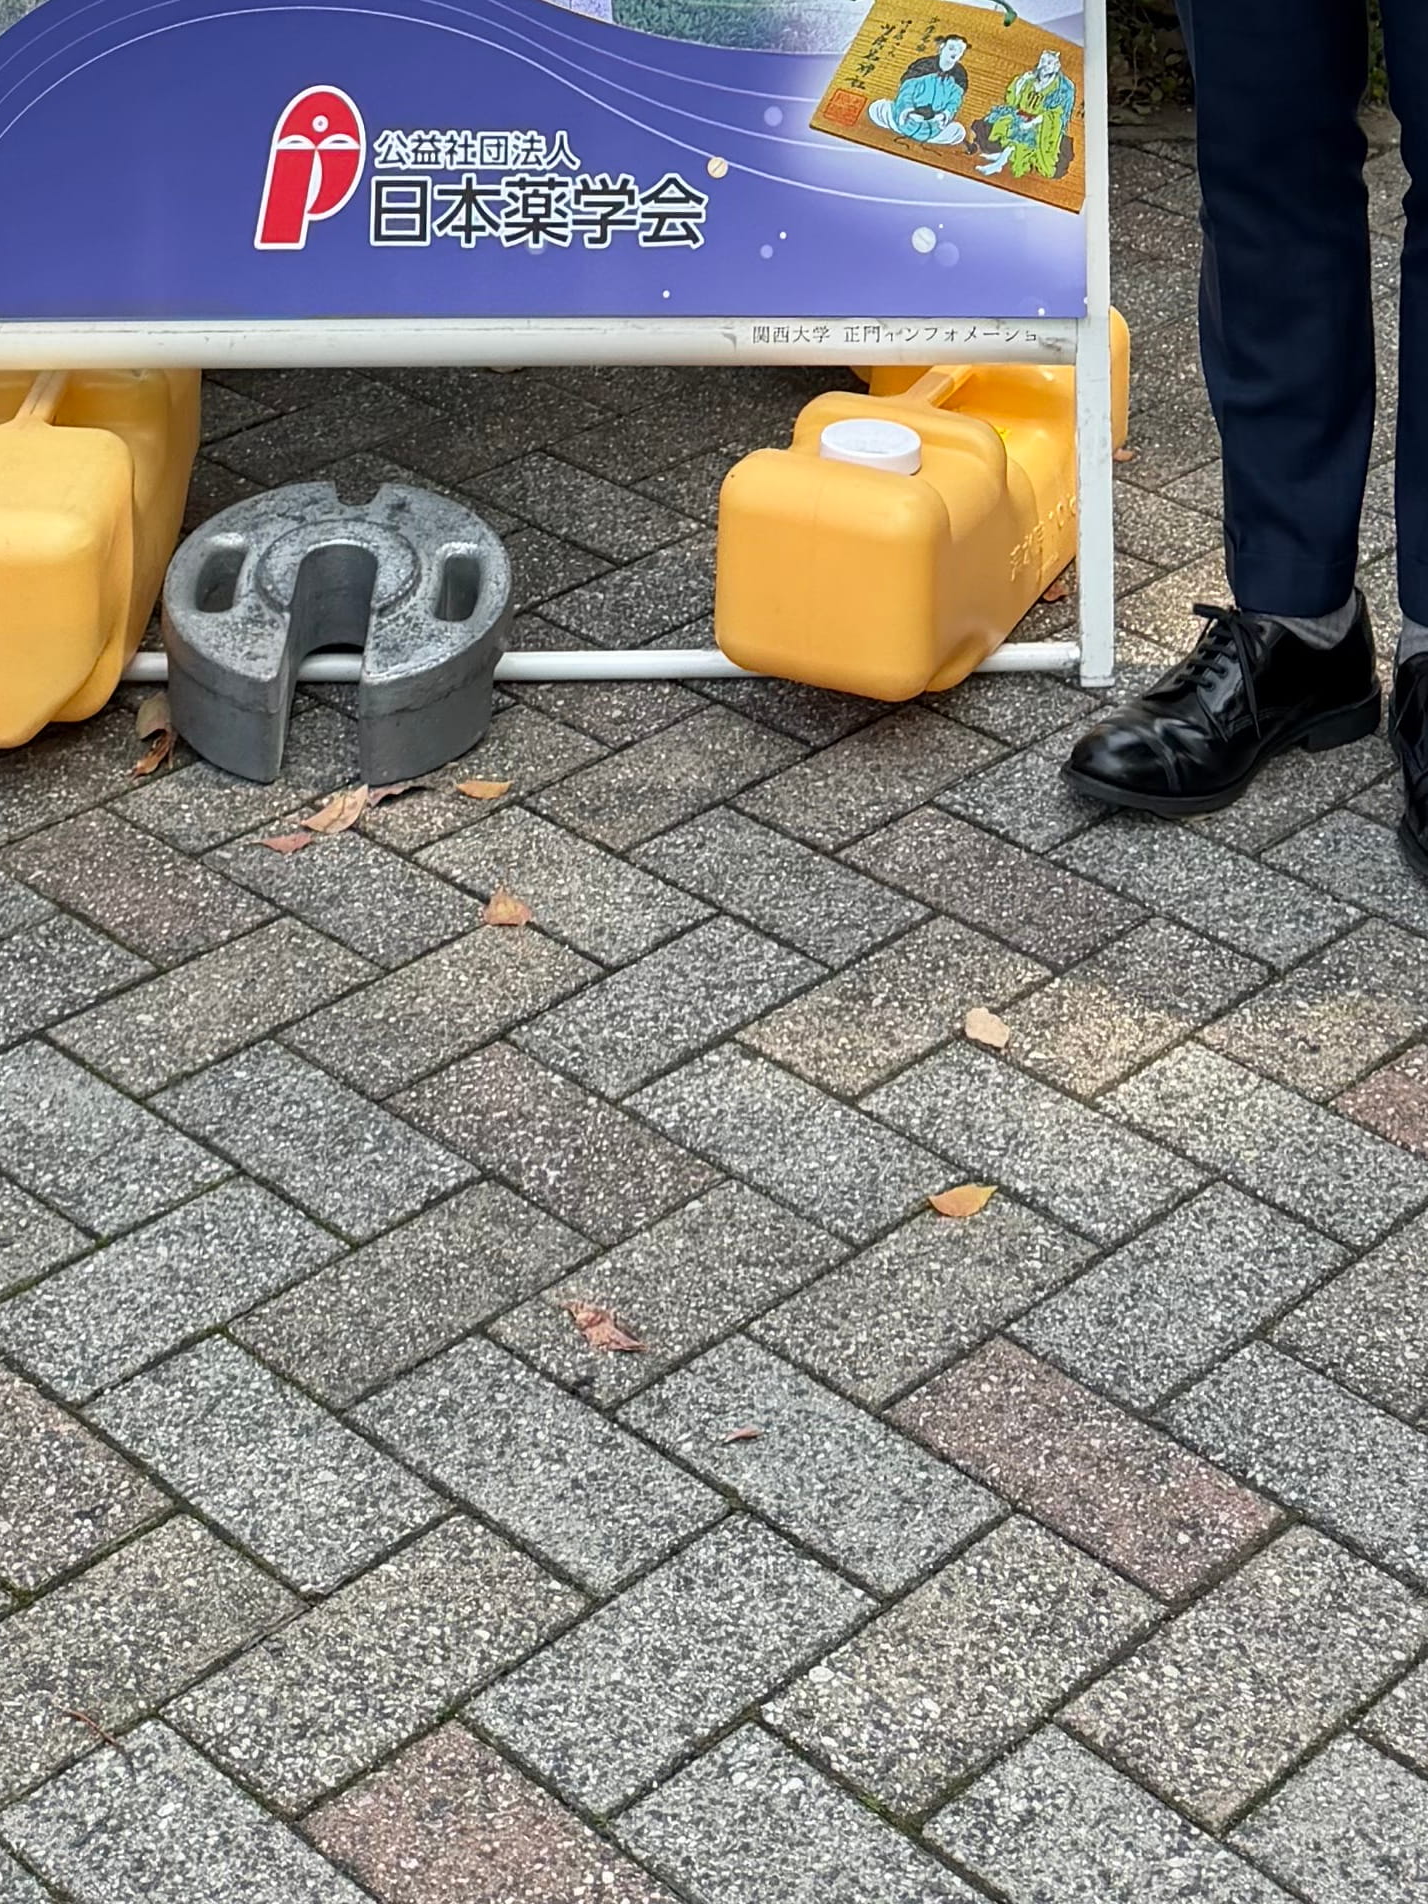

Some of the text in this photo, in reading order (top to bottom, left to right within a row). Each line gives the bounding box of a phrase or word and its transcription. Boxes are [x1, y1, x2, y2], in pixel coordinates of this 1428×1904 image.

[374, 131, 579, 168] 公益社団法人
[373, 175, 706, 247] 日本薬学会
[752, 325, 831, 344] 関西大学
